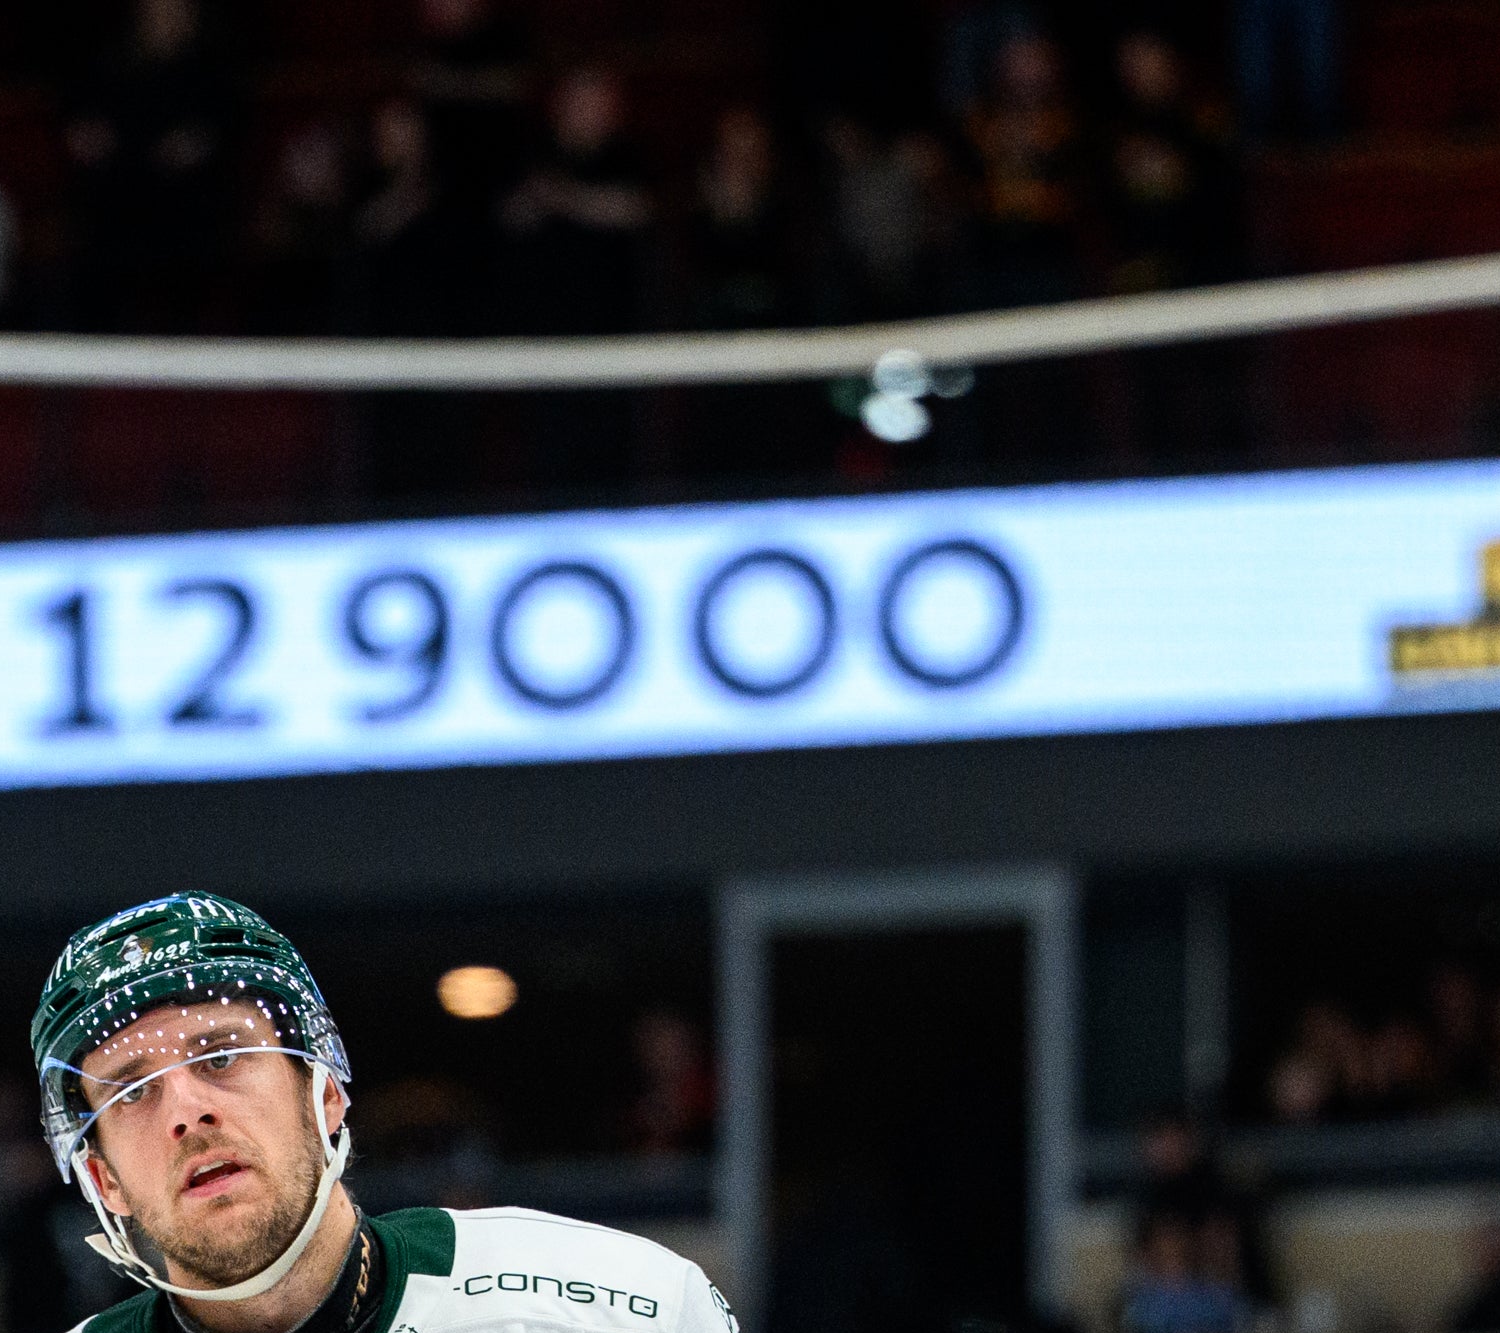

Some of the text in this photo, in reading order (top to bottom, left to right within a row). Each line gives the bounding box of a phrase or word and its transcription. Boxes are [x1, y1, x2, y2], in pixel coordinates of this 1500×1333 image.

[31, 537, 1030, 740] 12 9000
[144, 940, 192, 965] 1698
